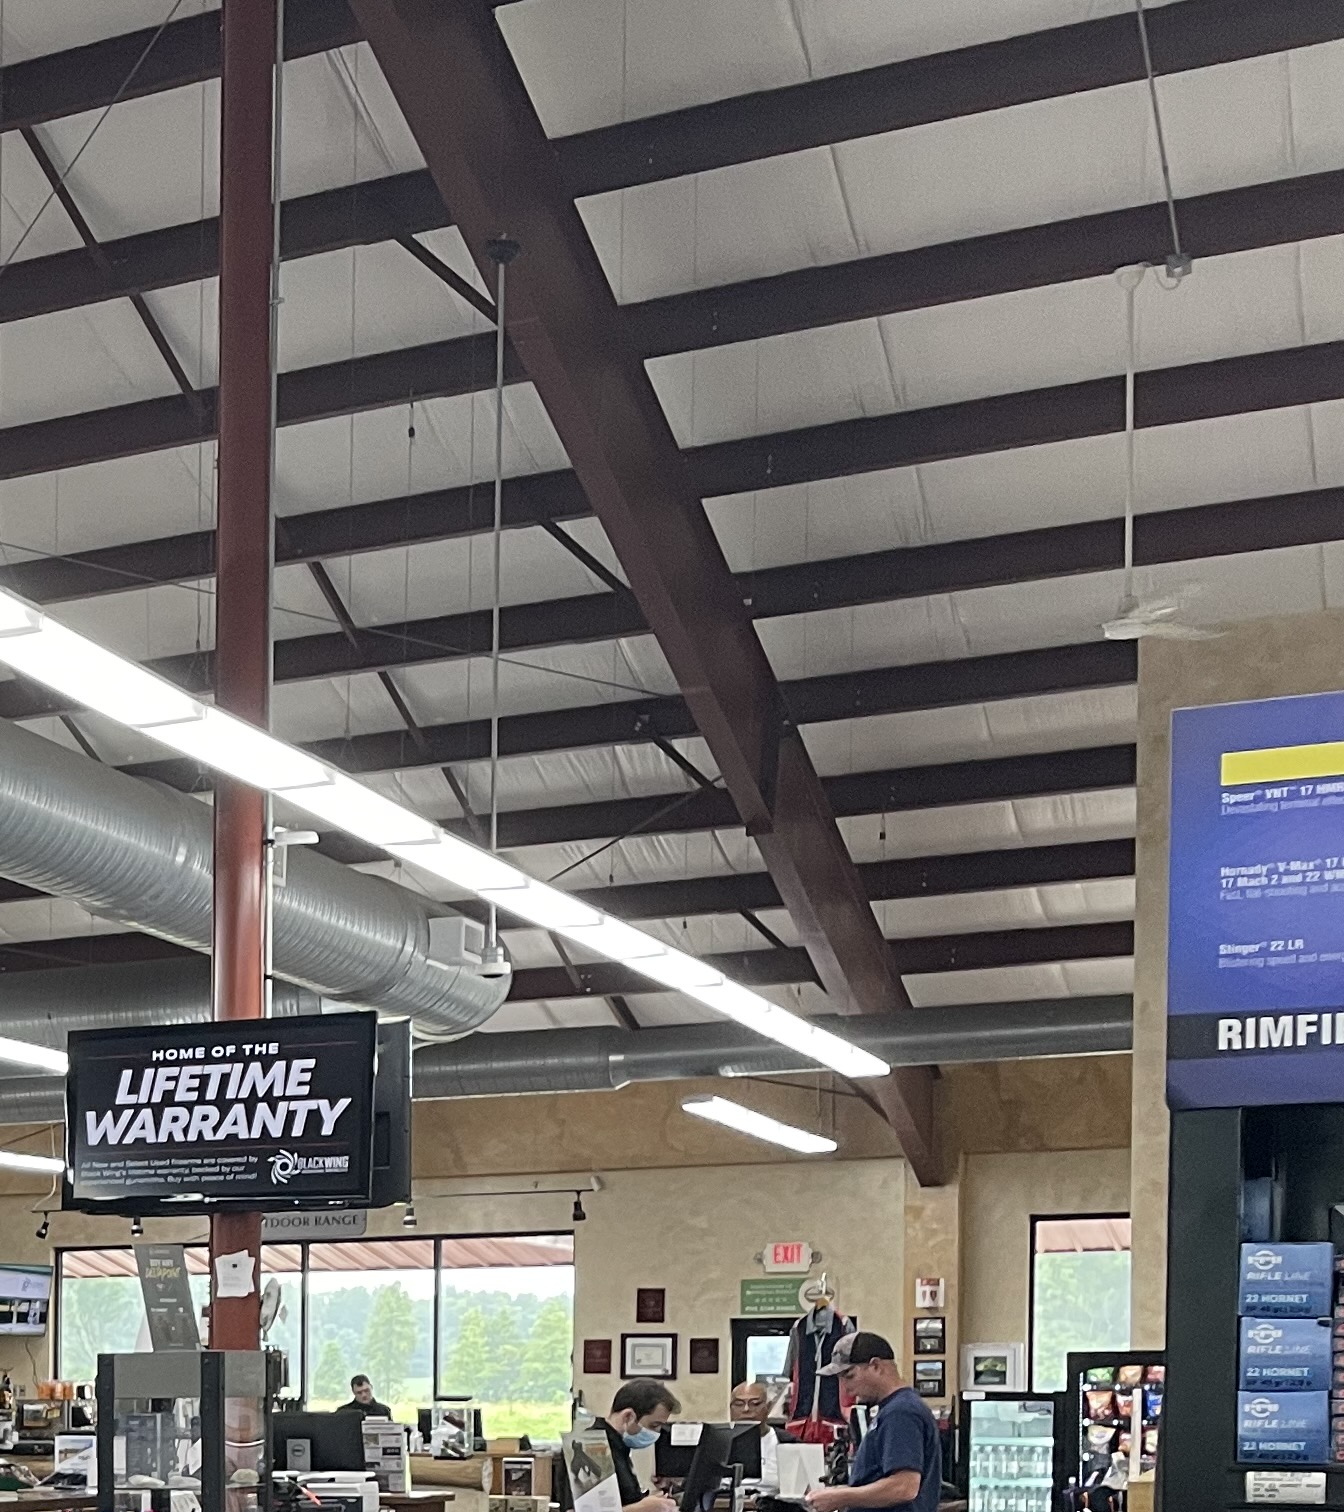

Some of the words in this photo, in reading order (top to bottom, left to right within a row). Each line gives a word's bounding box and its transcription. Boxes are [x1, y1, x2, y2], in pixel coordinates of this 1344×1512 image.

[1300, 785, 1313, 795] 17
[1221, 878, 1234, 888] 17
[1306, 871, 1320, 882] 22
[1269, 941, 1286, 952] 22
[1288, 940, 1304, 951] LR
[152, 1047, 206, 1062] HOME
[212, 1045, 236, 1058] OF
[242, 1042, 279, 1056] THE
[115, 1057, 316, 1106] LIFETIME
[84, 1097, 352, 1147] WARRANTY
[298, 1155, 350, 1169] BLACKWING
[314, 1214, 358, 1227] RANGE
[772, 1244, 803, 1265] EXIT
[1245, 1294, 1259, 1302] 22
[1246, 1368, 1260, 1376] 22
[1262, 1368, 1310, 1377] HORNET
